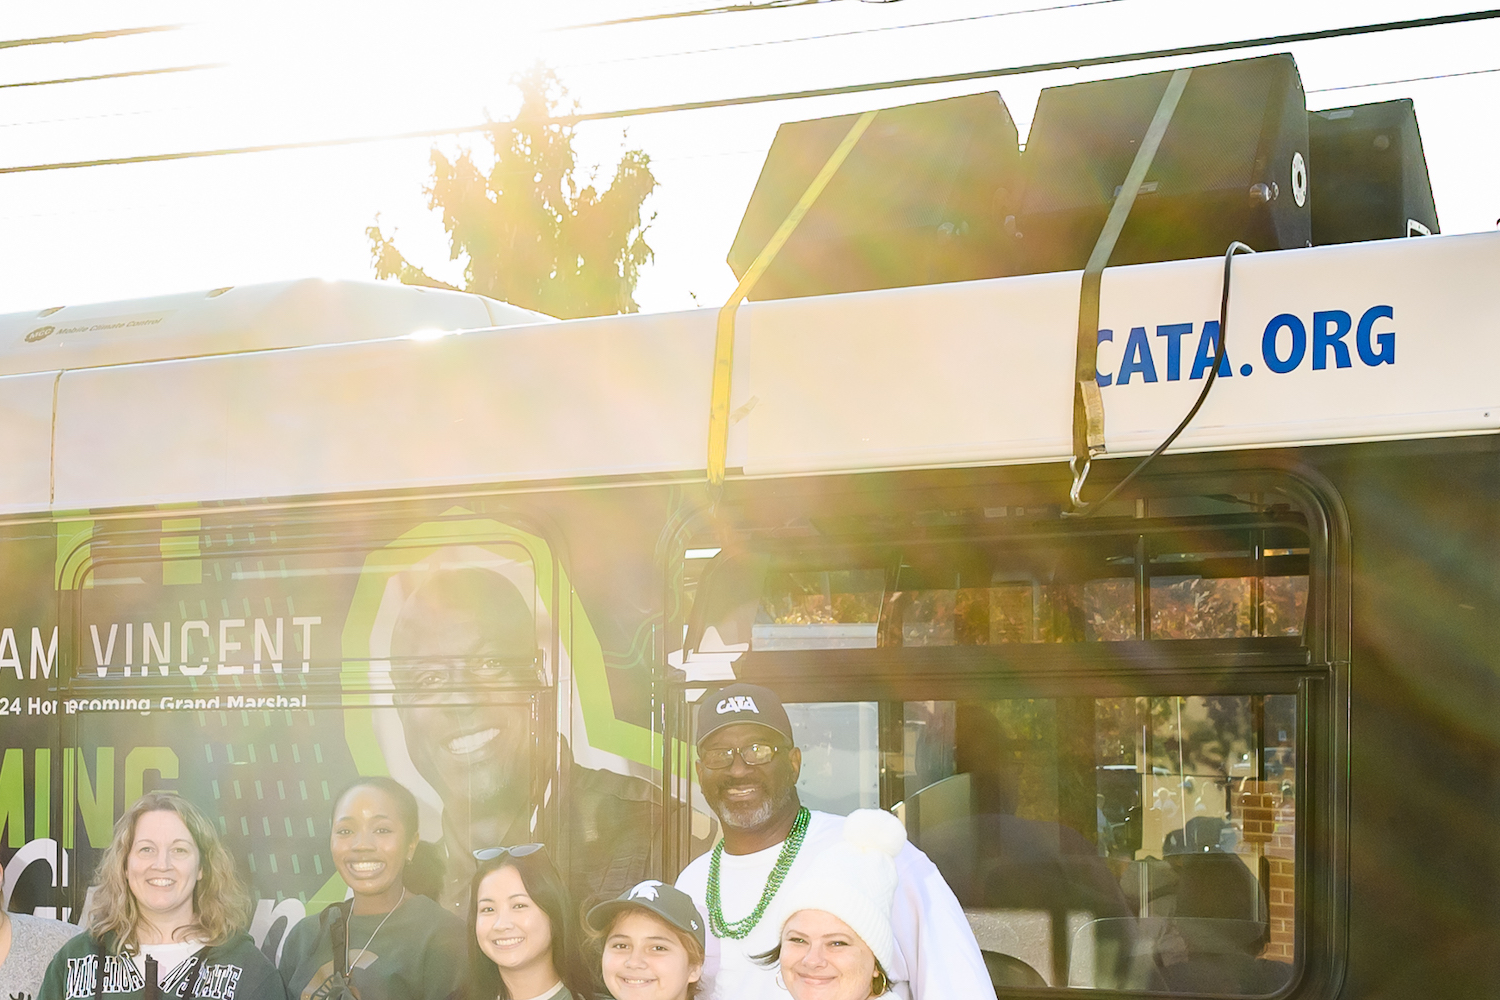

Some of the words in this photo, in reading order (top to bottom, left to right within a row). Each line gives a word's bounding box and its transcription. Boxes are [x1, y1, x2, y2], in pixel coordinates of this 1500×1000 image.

[56, 325, 89, 335] Mobile
[90, 322, 125, 332] Climate
[126, 317, 163, 327] Control
[1096, 305, 1396, 387] CATA.ORG
[90, 616, 322, 678] VINCENT
[716, 696, 759, 714] CATA
